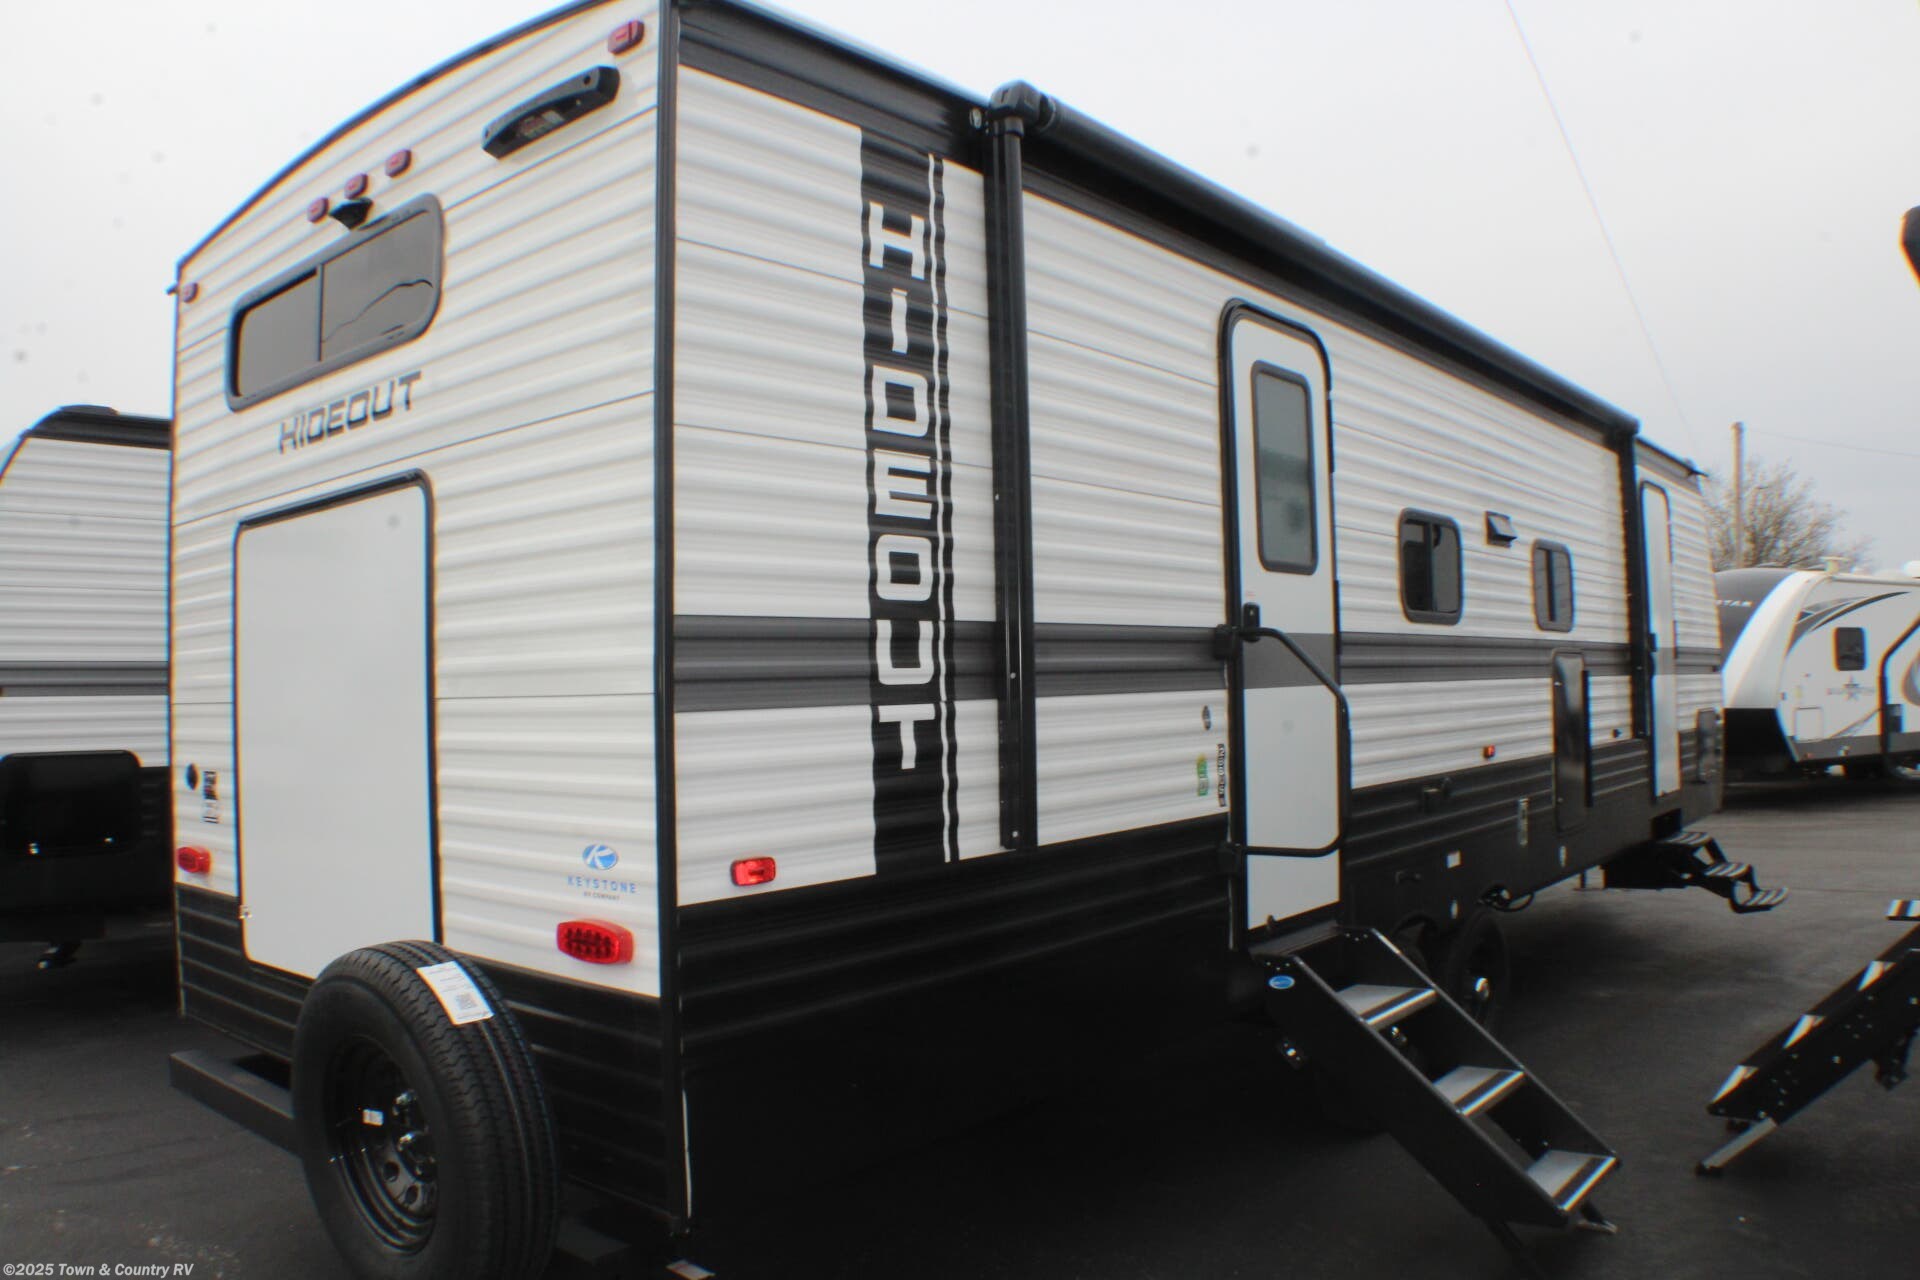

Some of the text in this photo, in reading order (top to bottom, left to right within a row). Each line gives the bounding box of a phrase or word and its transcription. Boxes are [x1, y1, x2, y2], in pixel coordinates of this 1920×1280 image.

[278, 370, 422, 454] HIDEOUT
[868, 201, 936, 769] HIDEOUT
[567, 875, 637, 894] KEYSTONE
